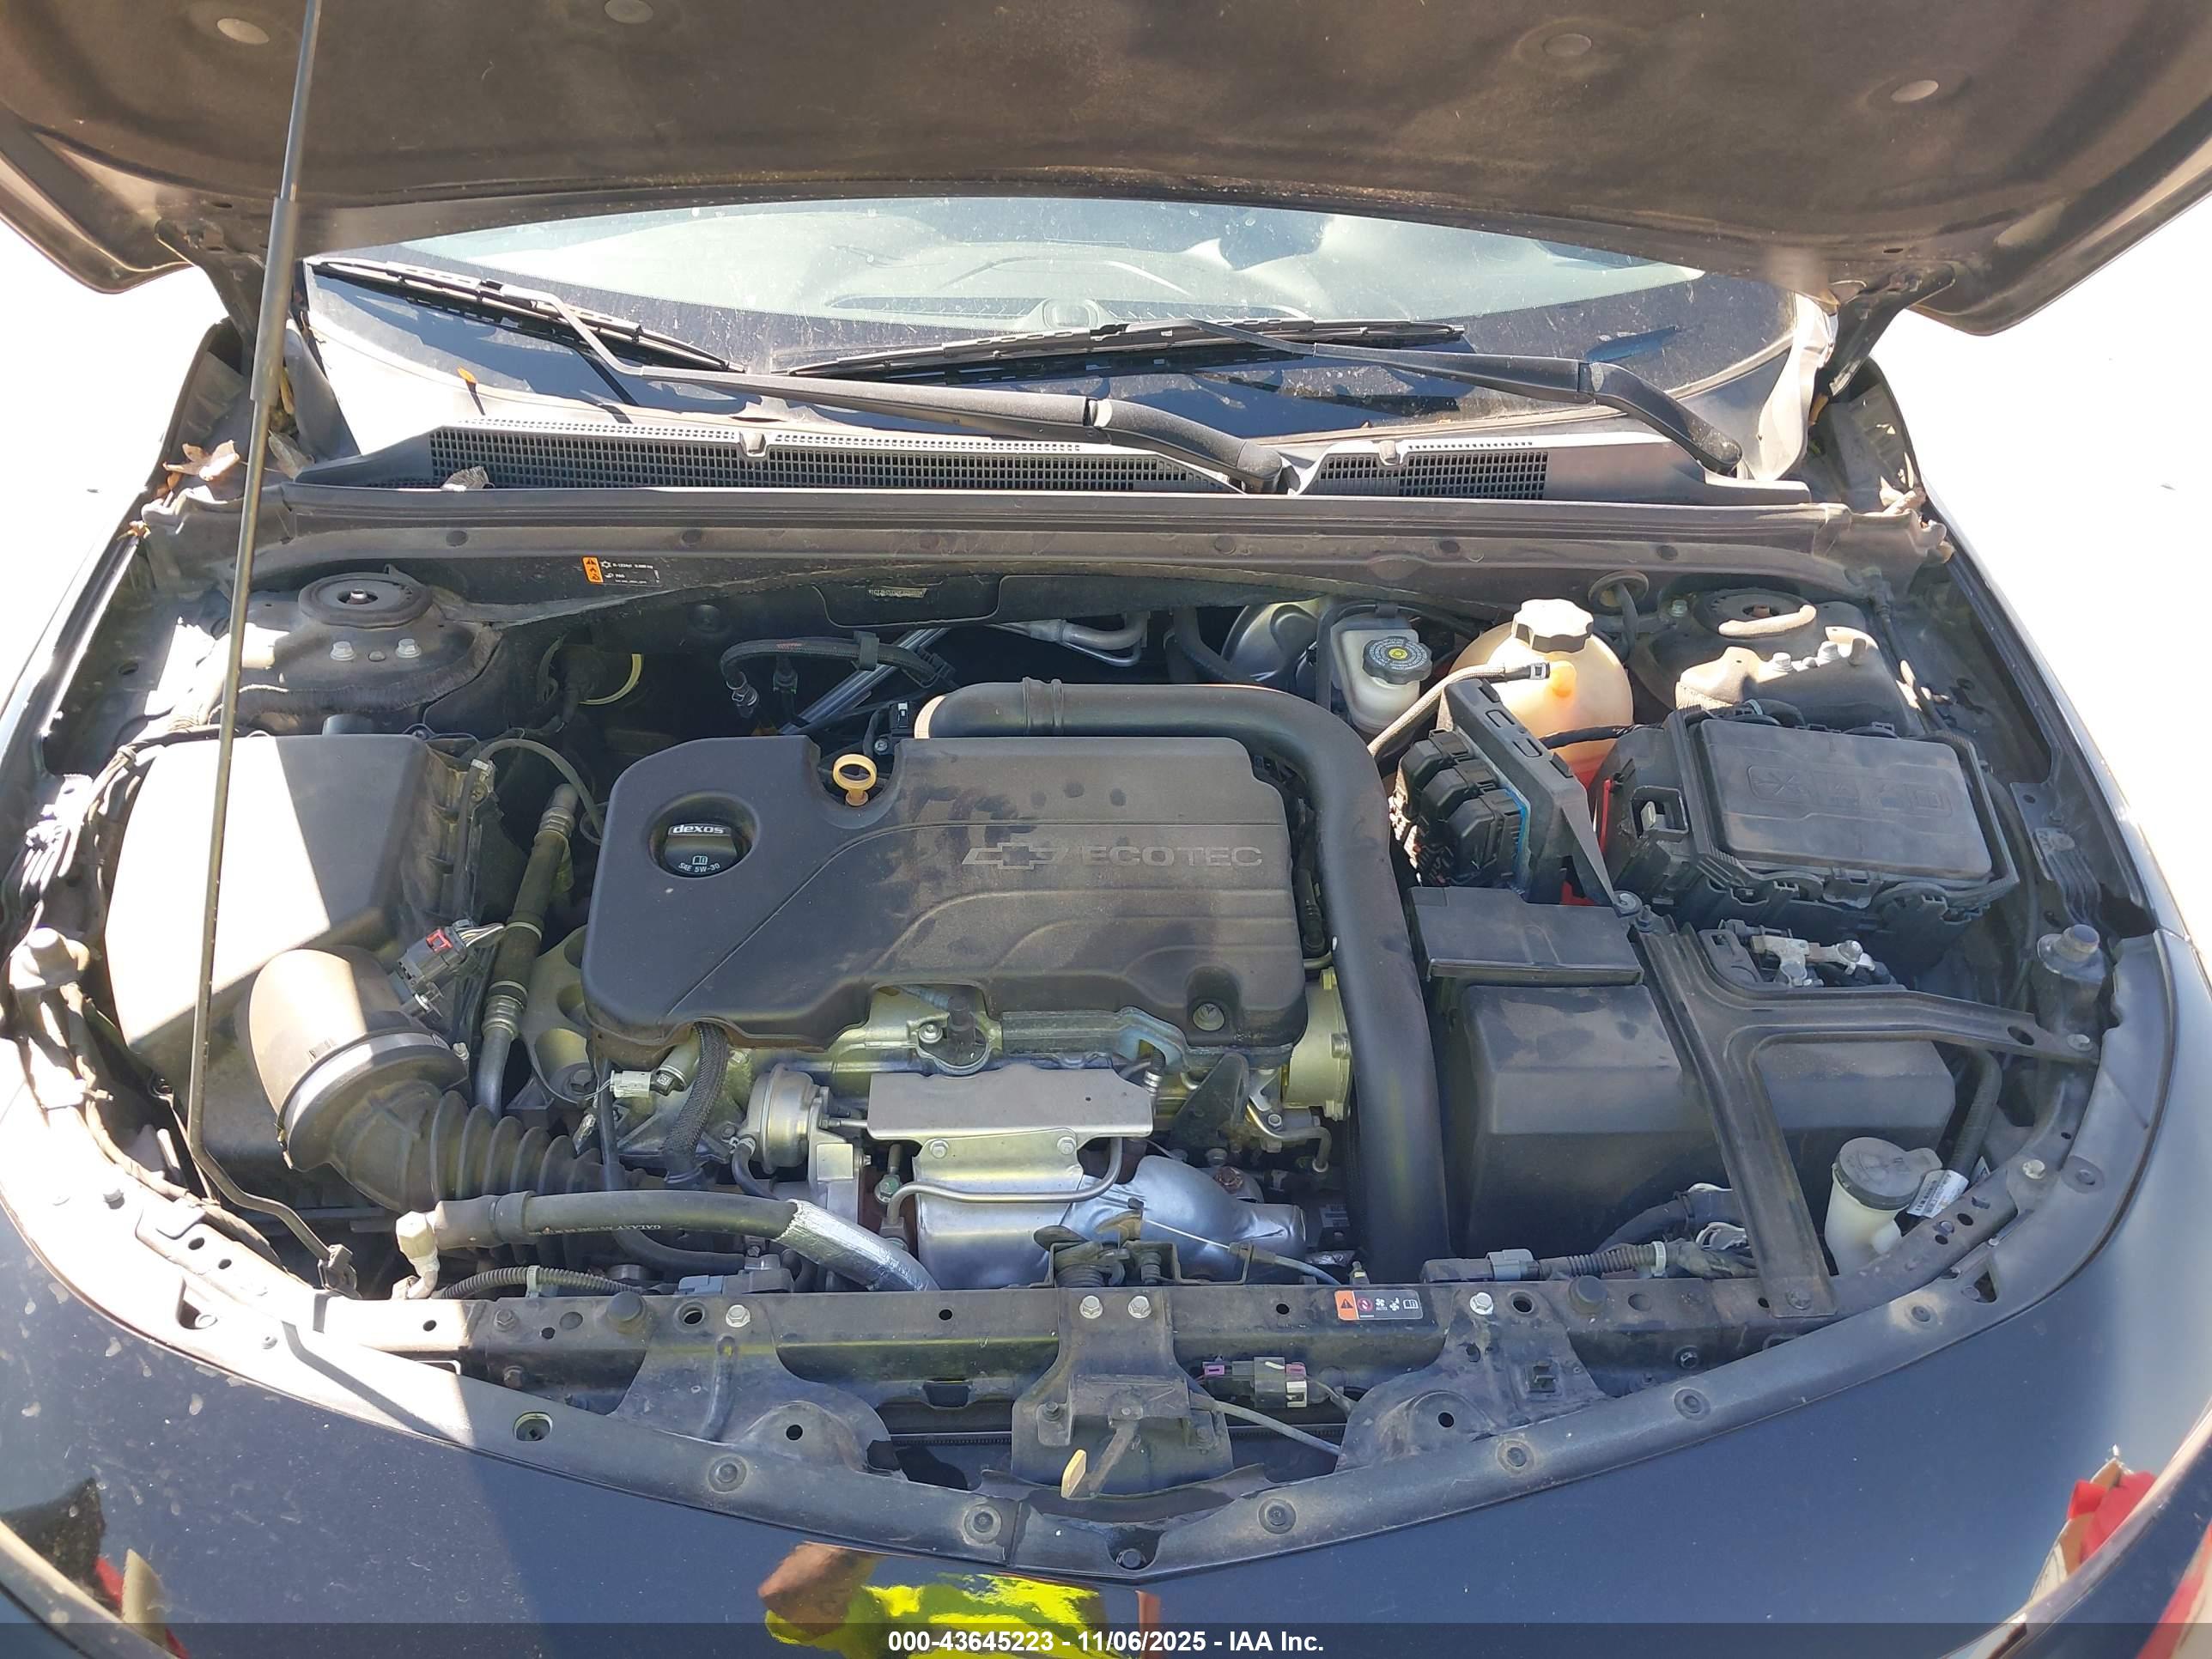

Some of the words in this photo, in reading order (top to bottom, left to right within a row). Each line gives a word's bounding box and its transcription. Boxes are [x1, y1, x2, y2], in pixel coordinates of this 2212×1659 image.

[672, 824, 724, 834] dexos
[1082, 845, 1262, 866] ECOTEC
[678, 862, 692, 872] SAE
[694, 863, 720, 873] 5W-30
